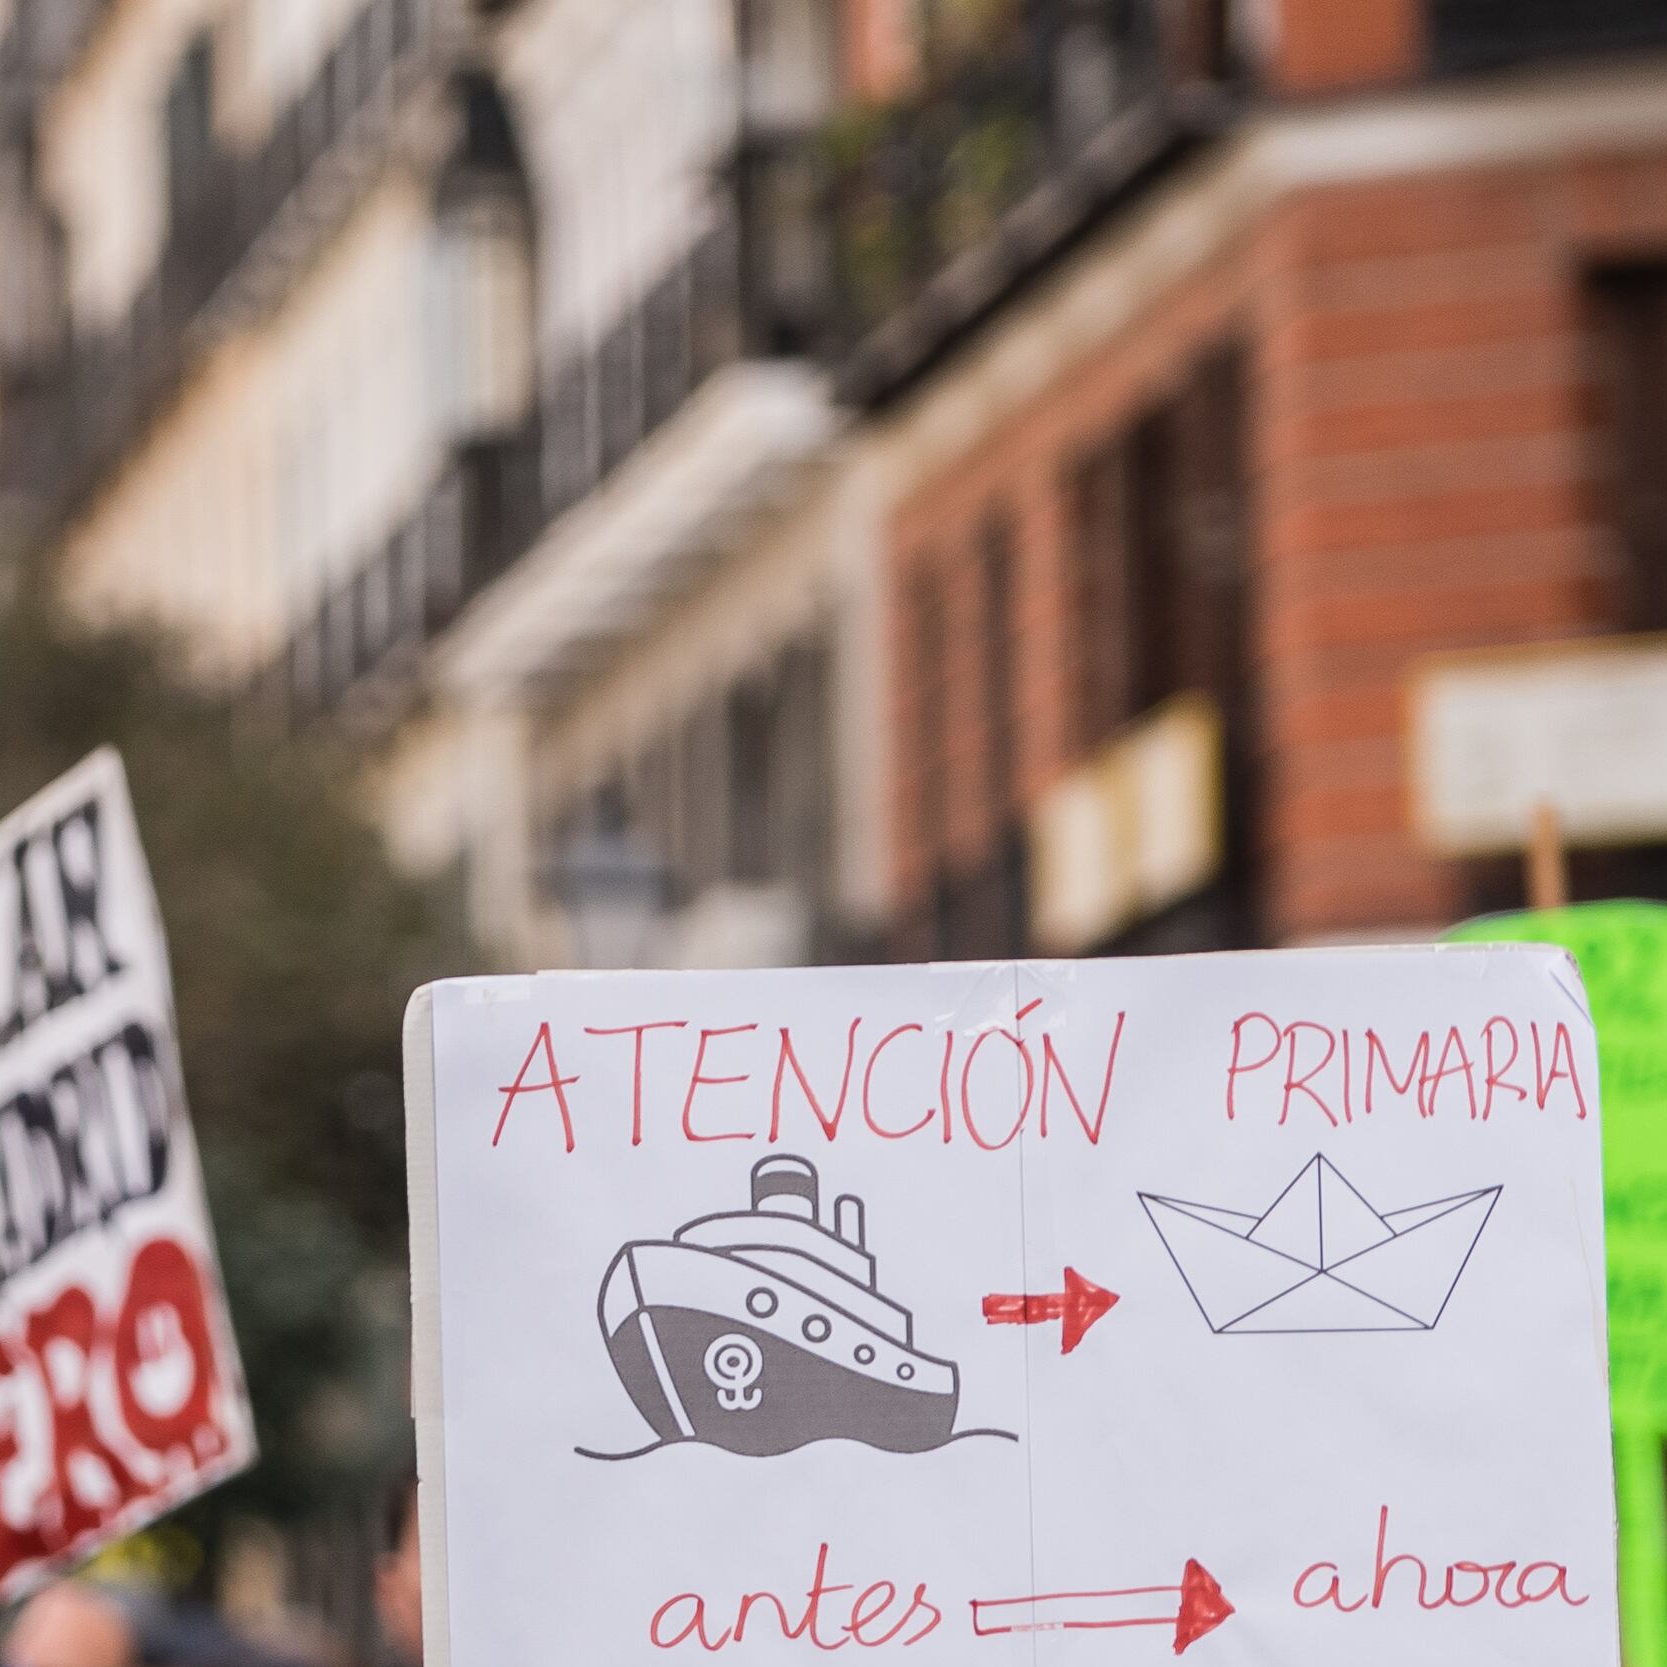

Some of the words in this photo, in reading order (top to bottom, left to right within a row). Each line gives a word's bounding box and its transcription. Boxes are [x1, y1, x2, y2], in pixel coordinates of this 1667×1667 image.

[492, 997, 1126, 1151] ATENCIÓN
[1225, 1012, 1587, 1127] PRIMARIA
[649, 1541, 944, 1652] antes
[1291, 1504, 1590, 1612] ahora
